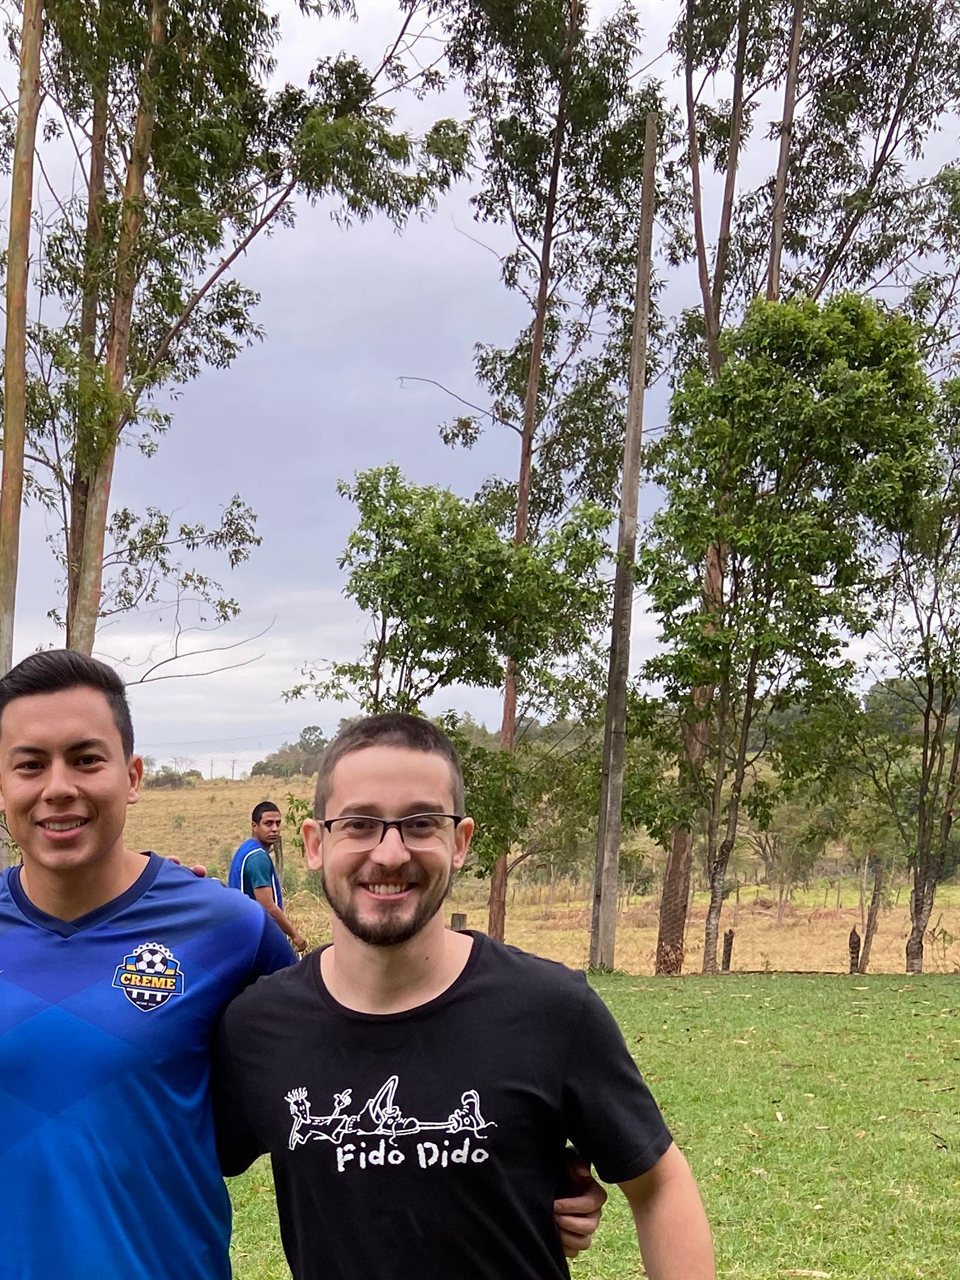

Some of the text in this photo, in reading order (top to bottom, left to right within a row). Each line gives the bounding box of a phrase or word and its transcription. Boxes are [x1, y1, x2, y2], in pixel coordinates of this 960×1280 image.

[120, 973, 176, 990] CREME
[336, 1138, 489, 1172] Fido Dido
